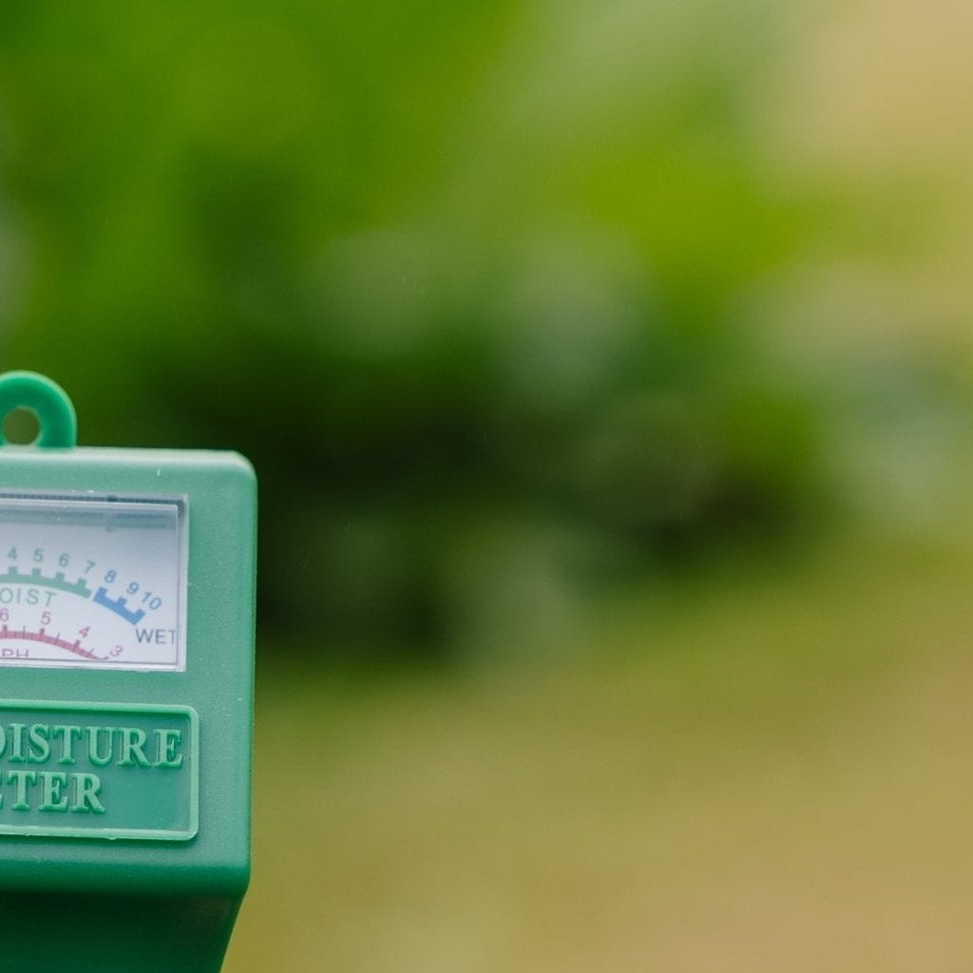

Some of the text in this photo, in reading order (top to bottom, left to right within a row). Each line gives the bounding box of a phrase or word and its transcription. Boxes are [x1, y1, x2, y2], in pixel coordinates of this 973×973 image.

[7, 547, 18, 561] 4
[33, 548, 44, 563] 5
[58, 553, 70, 568] 6
[84, 560, 96, 574] 7
[104, 569, 117, 584] 8
[127, 581, 140, 596] 9
[140, 591, 163, 611] 10
[0, 608, 10, 622] 6
[40, 611, 52, 625] 5
[78, 626, 91, 639] 4
[109, 645, 123, 658] 3
